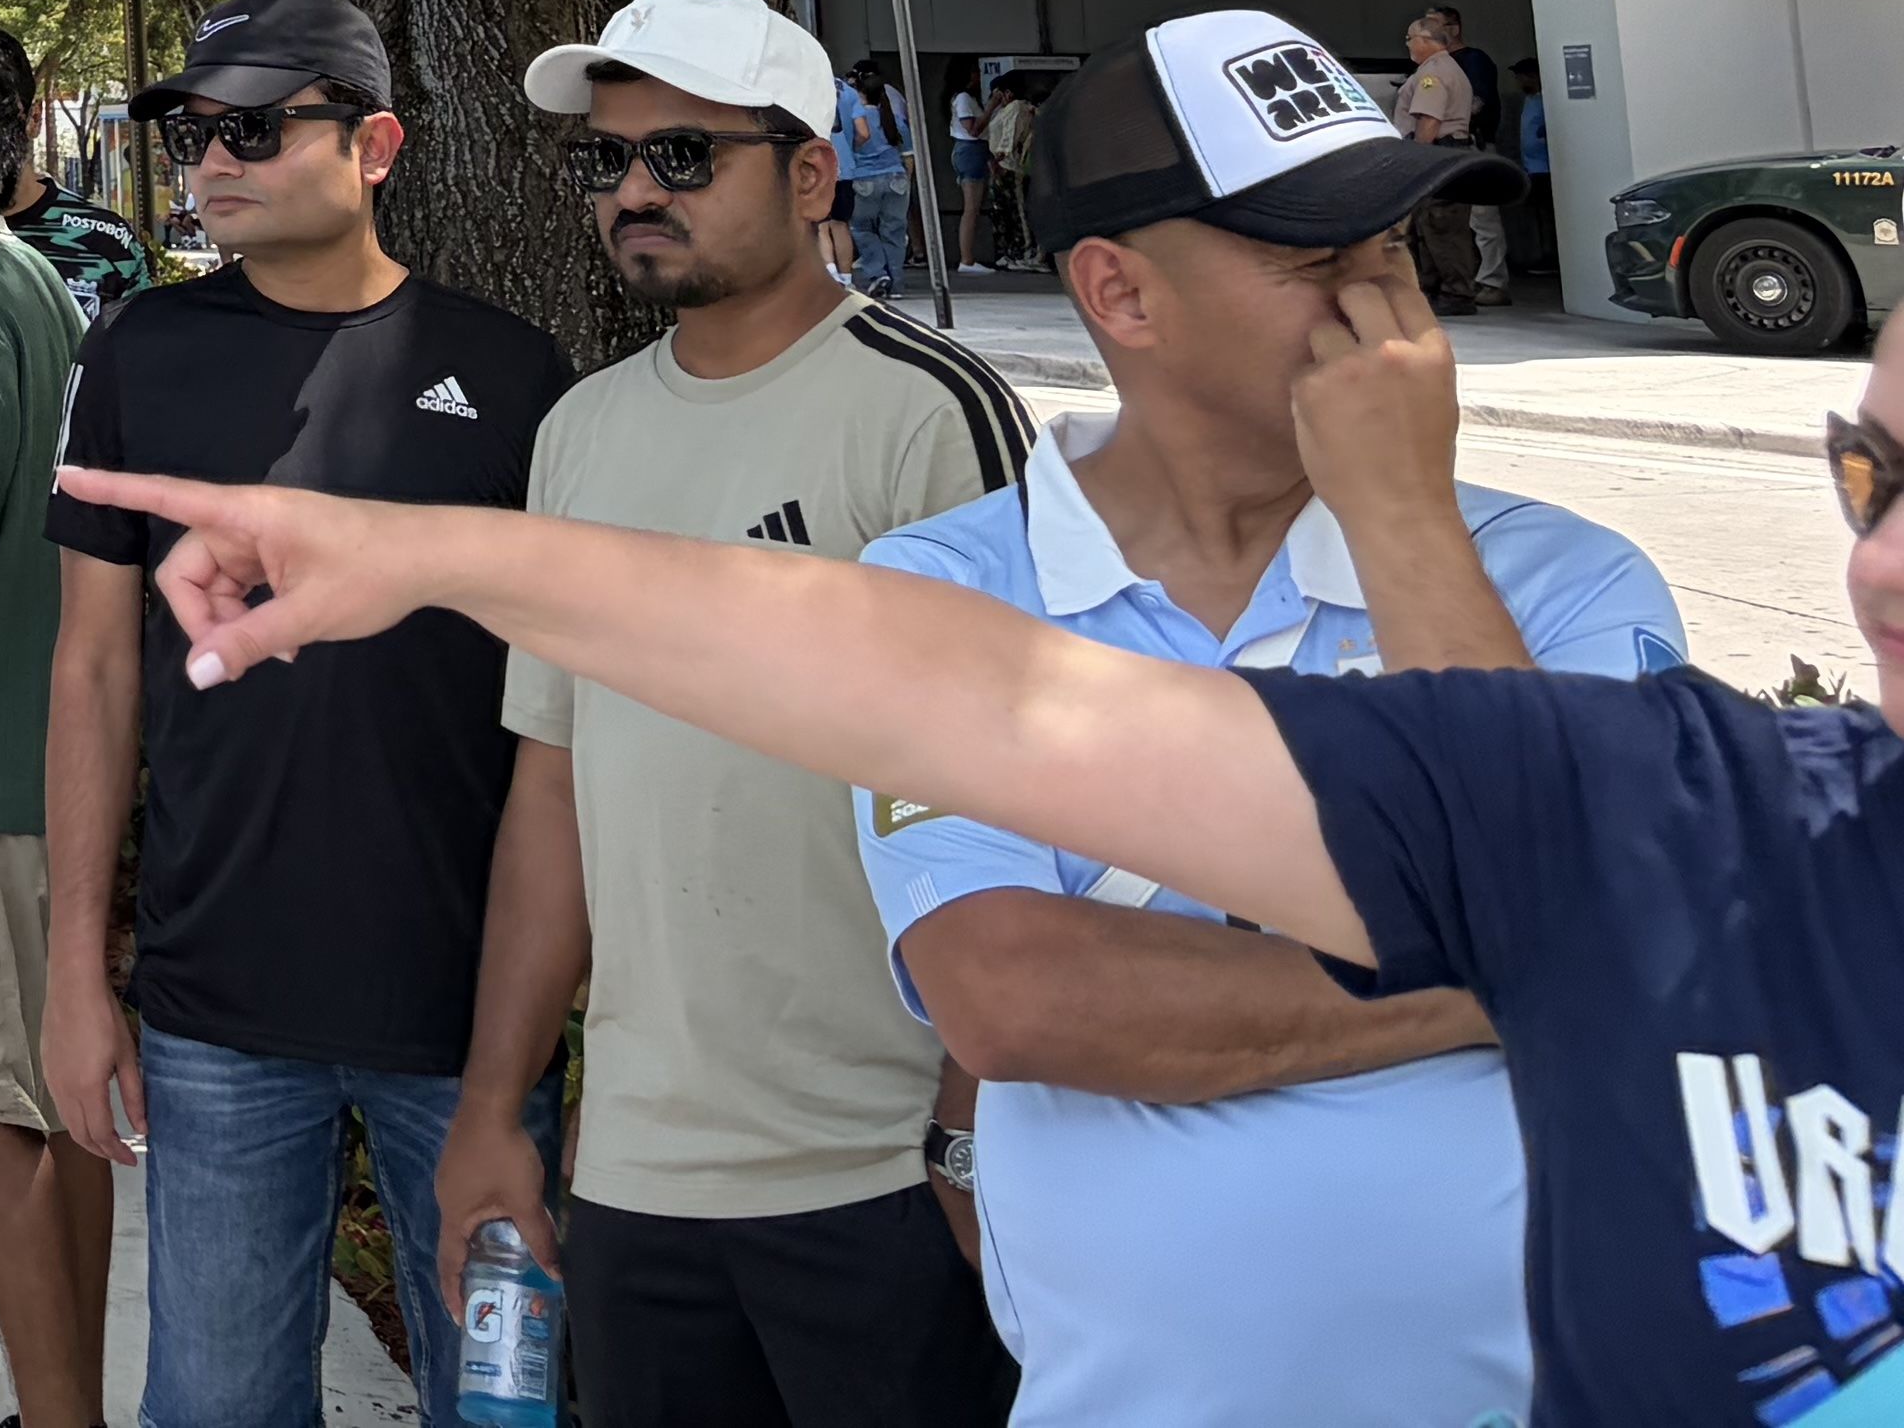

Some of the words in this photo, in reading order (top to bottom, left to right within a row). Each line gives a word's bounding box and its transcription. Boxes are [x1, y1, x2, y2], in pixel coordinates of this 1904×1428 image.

[1235, 47, 1331, 100] WE
[1832, 171, 1895, 186] 11172A
[415, 397, 478, 419] adidas
[1676, 1051, 1904, 1286] UR
